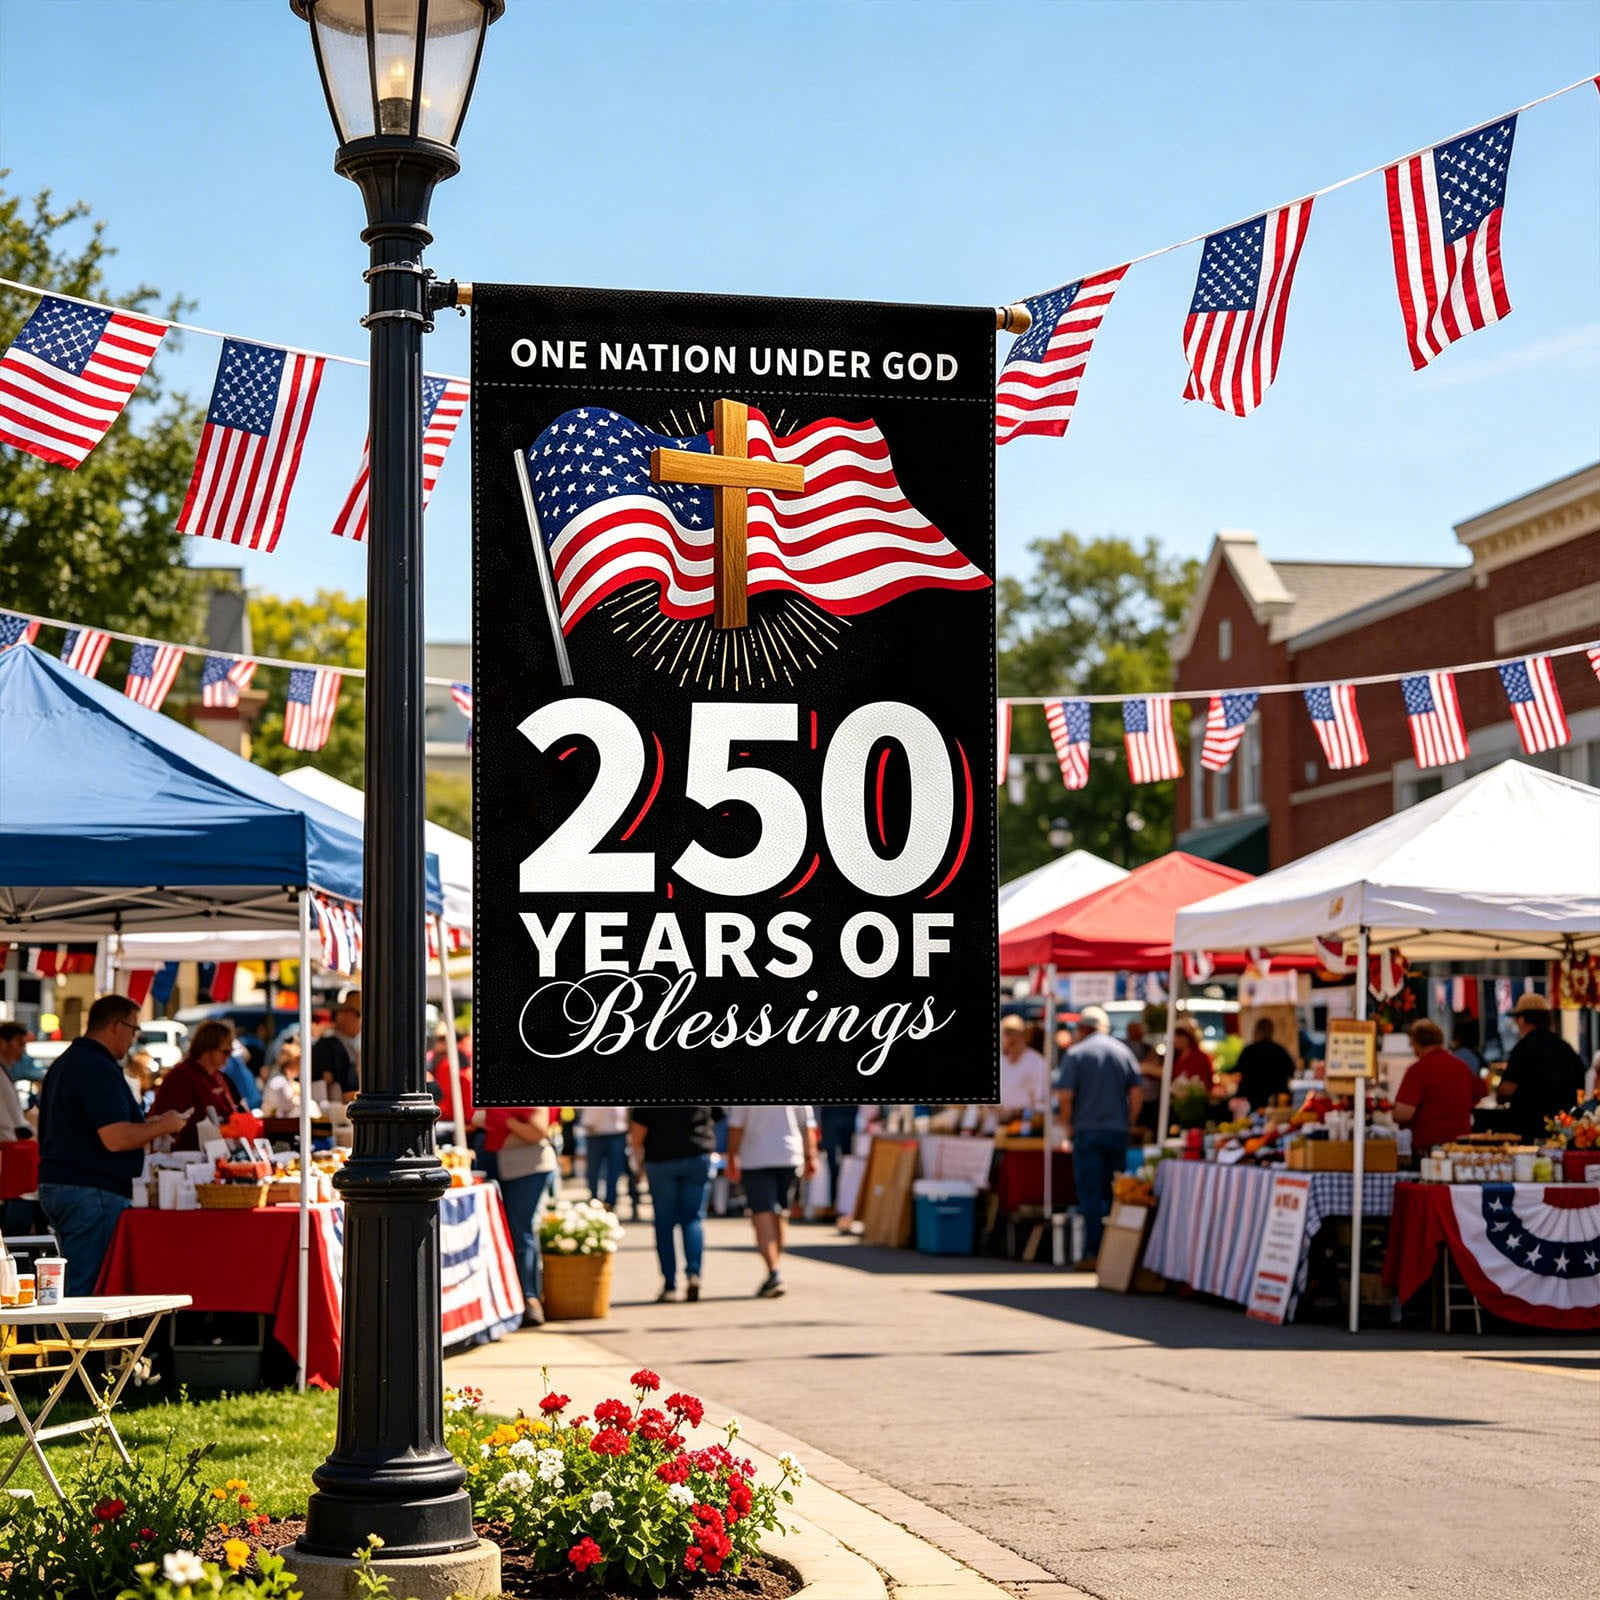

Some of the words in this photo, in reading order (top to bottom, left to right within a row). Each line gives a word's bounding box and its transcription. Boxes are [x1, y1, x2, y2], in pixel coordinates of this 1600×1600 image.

[510, 338, 588, 370] ONE
[600, 342, 737, 375] NATION
[749, 346, 872, 379] UNDER
[882, 351, 959, 382] GOD
[516, 697, 955, 898] 250
[518, 911, 814, 979] YEARS
[839, 911, 955, 979] OF
[518, 971, 957, 1077] Blessings
